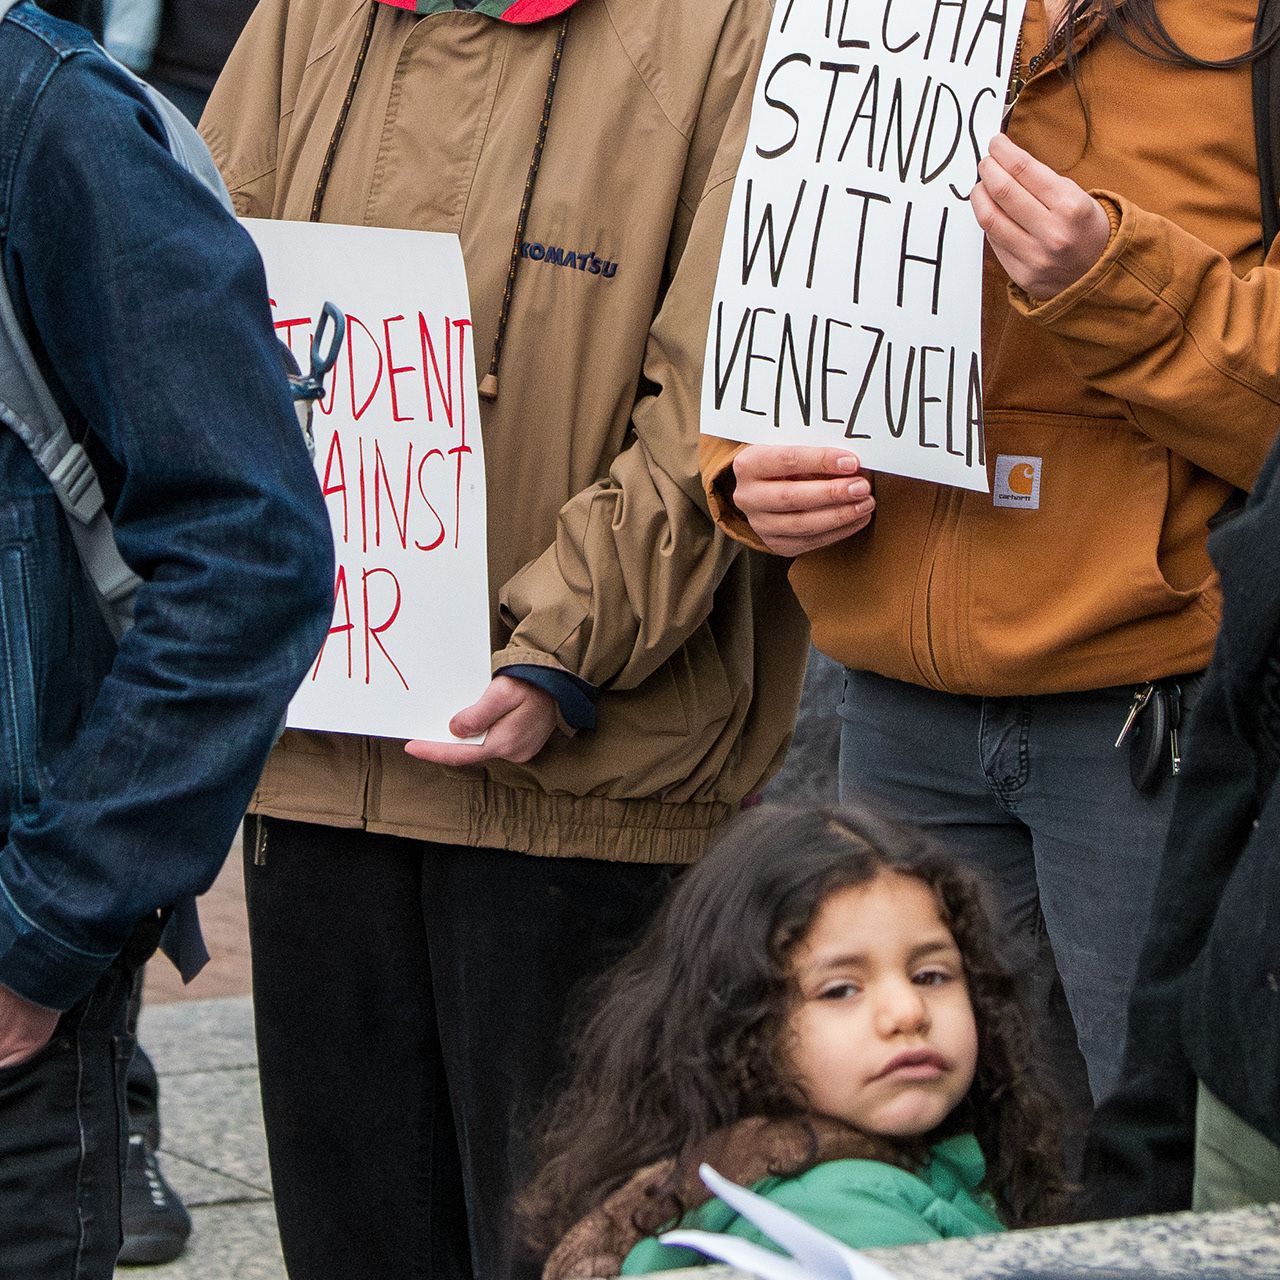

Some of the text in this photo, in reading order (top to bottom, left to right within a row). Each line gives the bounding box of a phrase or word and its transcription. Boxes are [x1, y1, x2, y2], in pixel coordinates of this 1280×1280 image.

[756, 53, 997, 201] STANDS
[742, 179, 948, 316] WITH
[269, 298, 472, 448] TUDENT
[715, 301, 985, 467] VENEZUELA
[322, 430, 473, 553] AINST
[312, 564, 410, 691] AR
